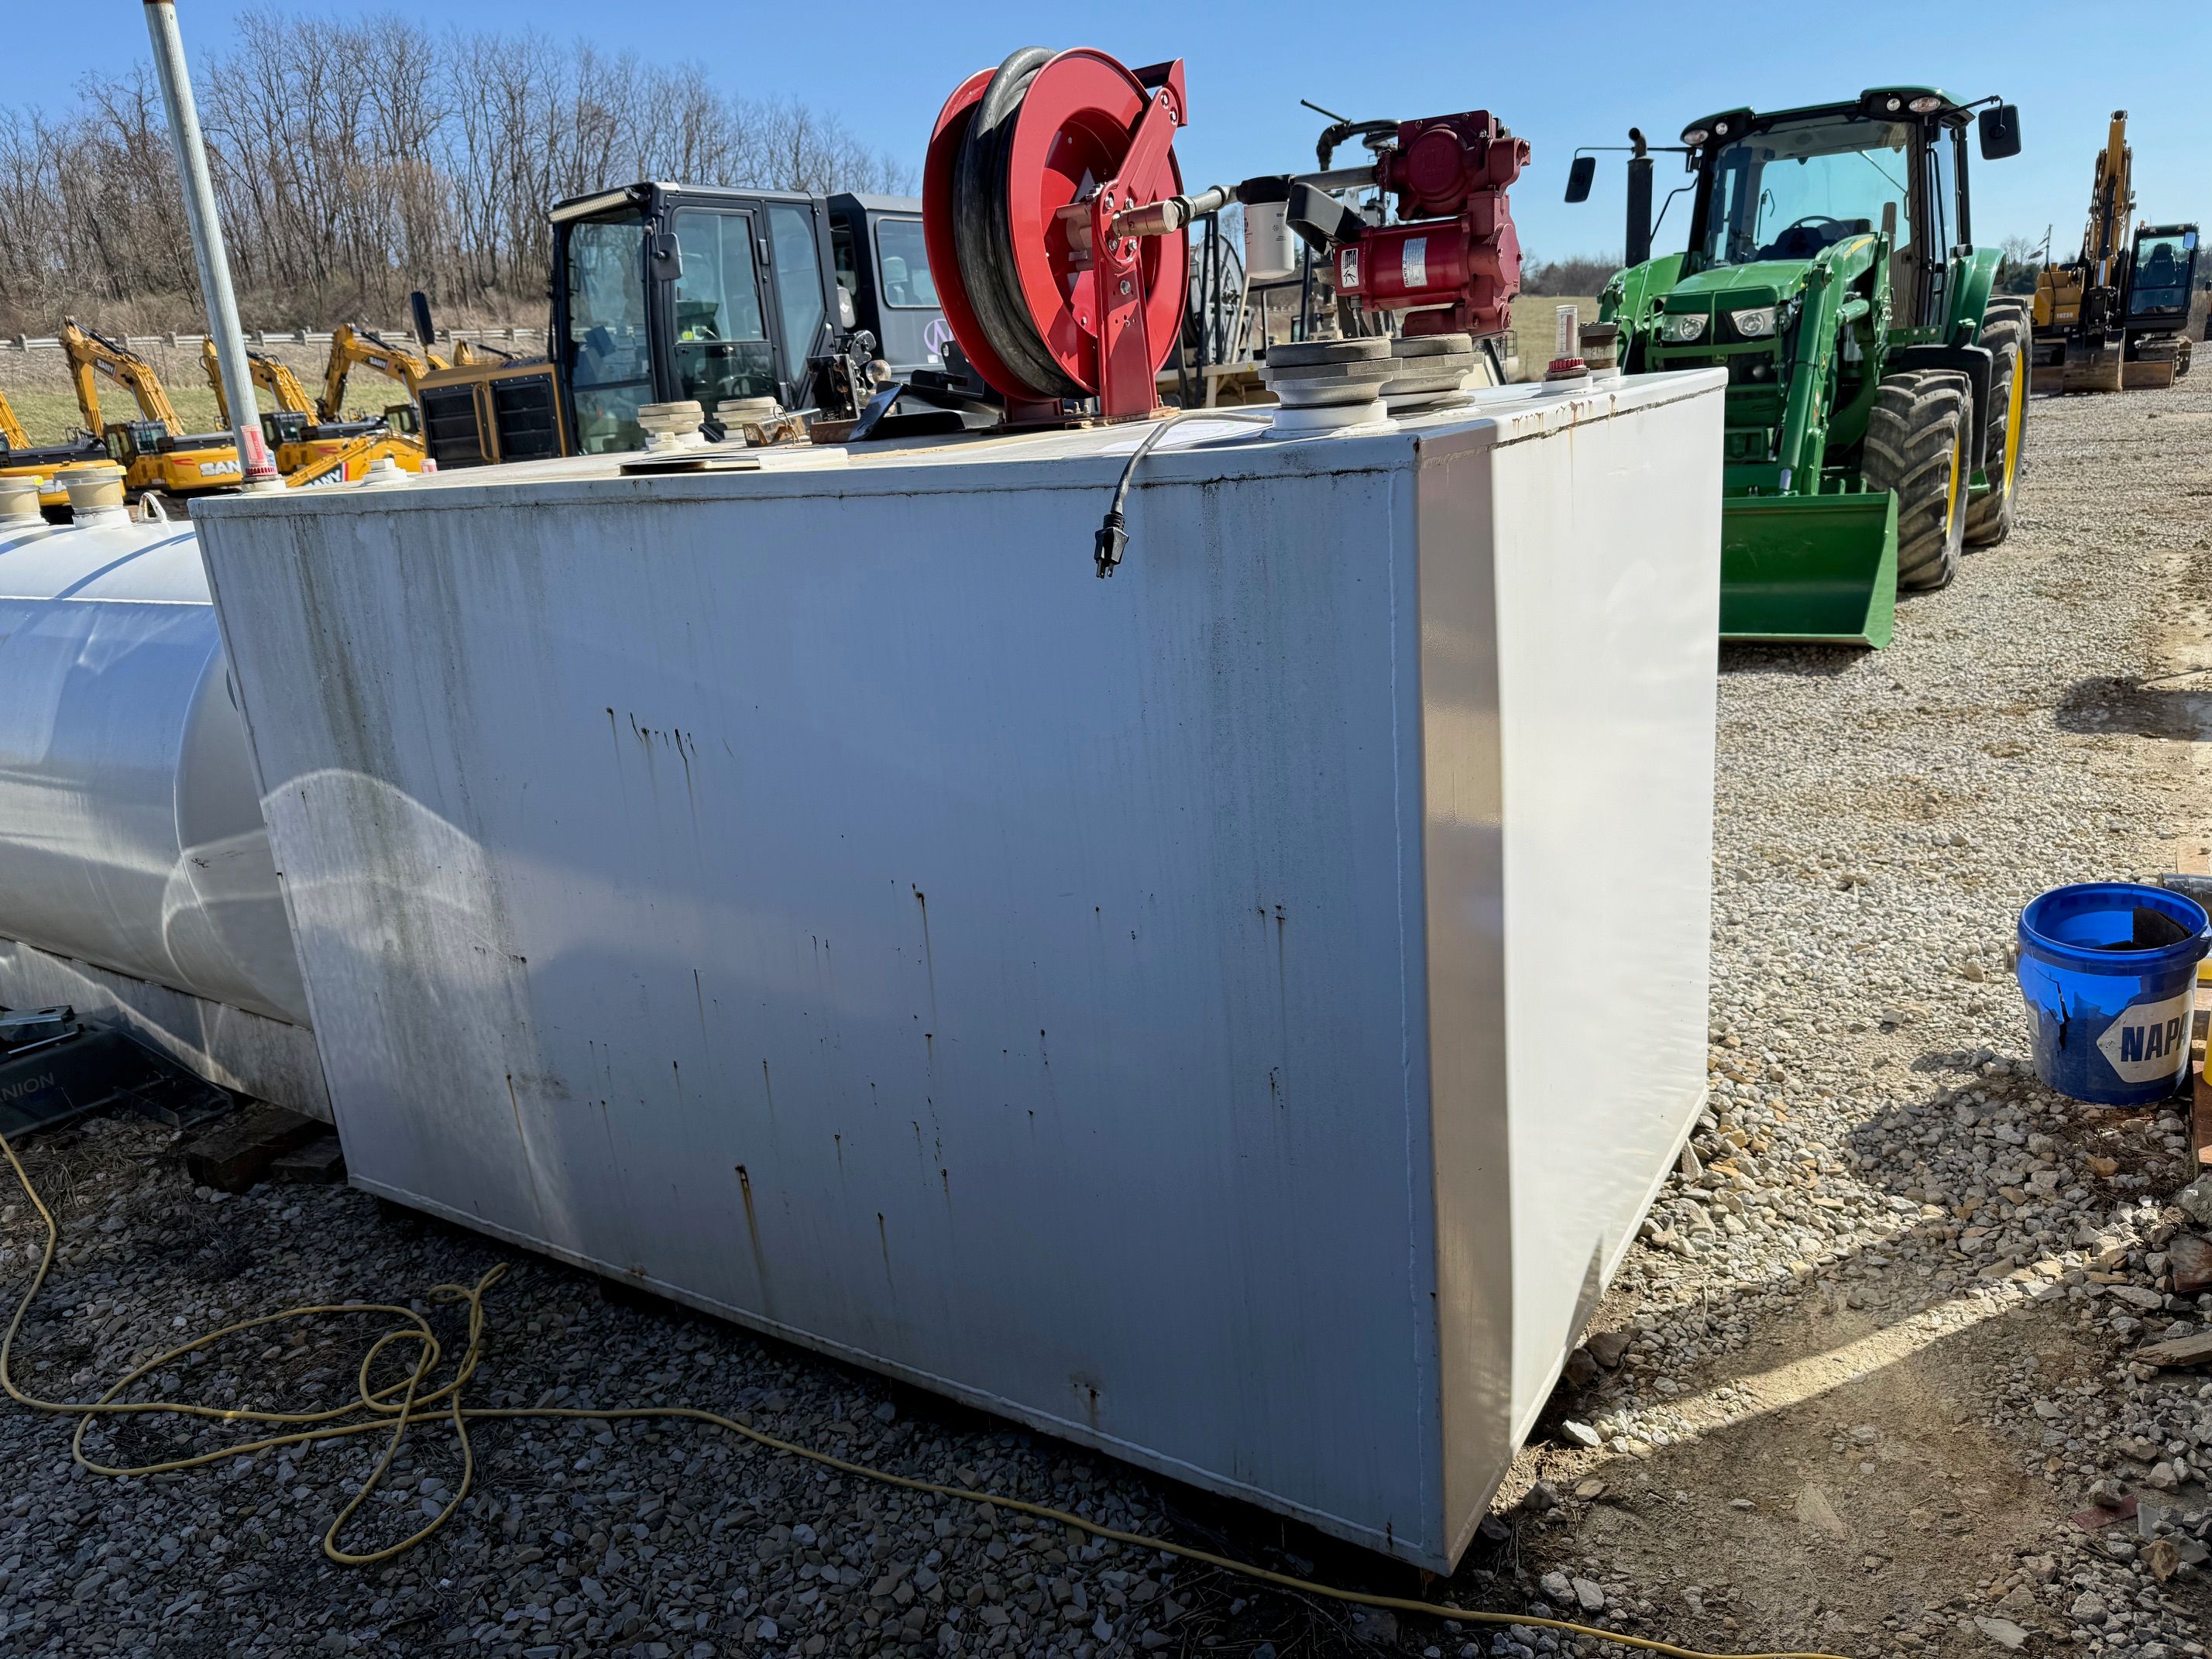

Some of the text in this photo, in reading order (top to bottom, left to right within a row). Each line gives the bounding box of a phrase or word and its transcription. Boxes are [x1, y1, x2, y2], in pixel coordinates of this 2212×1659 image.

[97, 358, 115, 373] SANY
[368, 356, 386, 369] SANY
[199, 460, 242, 476] SAN
[2121, 1010, 2189, 1062] NAPA
[0, 1072, 54, 1102] NION
